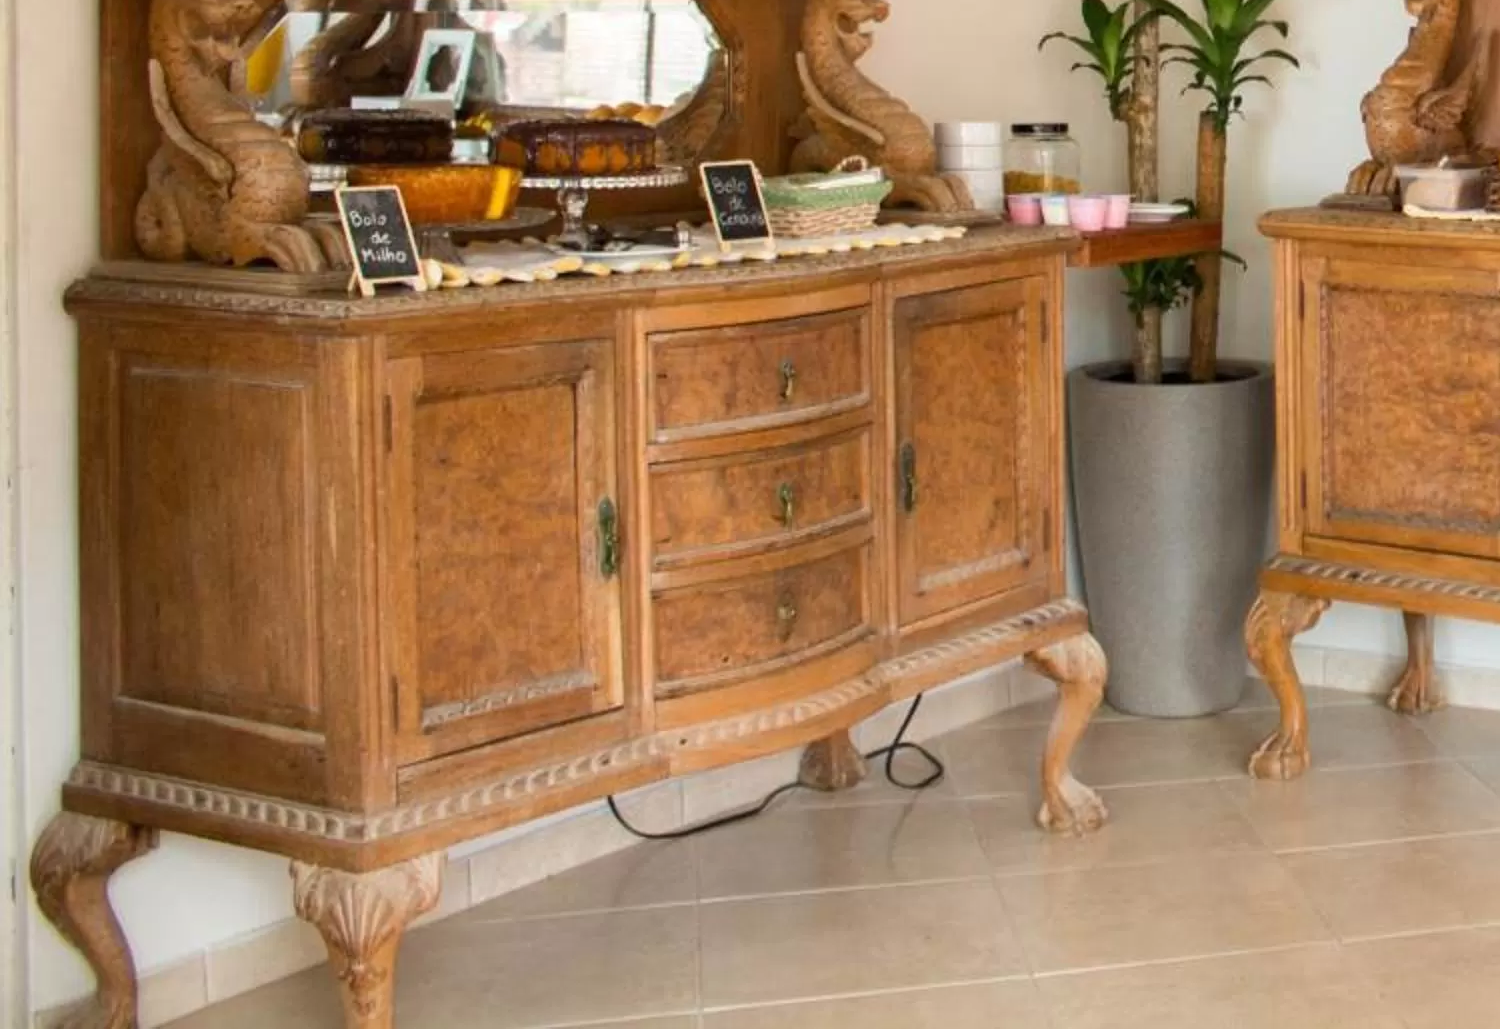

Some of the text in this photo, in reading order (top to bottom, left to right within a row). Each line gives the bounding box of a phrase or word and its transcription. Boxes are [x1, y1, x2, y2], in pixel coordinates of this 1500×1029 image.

[349, 210, 386, 227] Bolo
[370, 231, 391, 244] de
[361, 247, 407, 263] Milho
